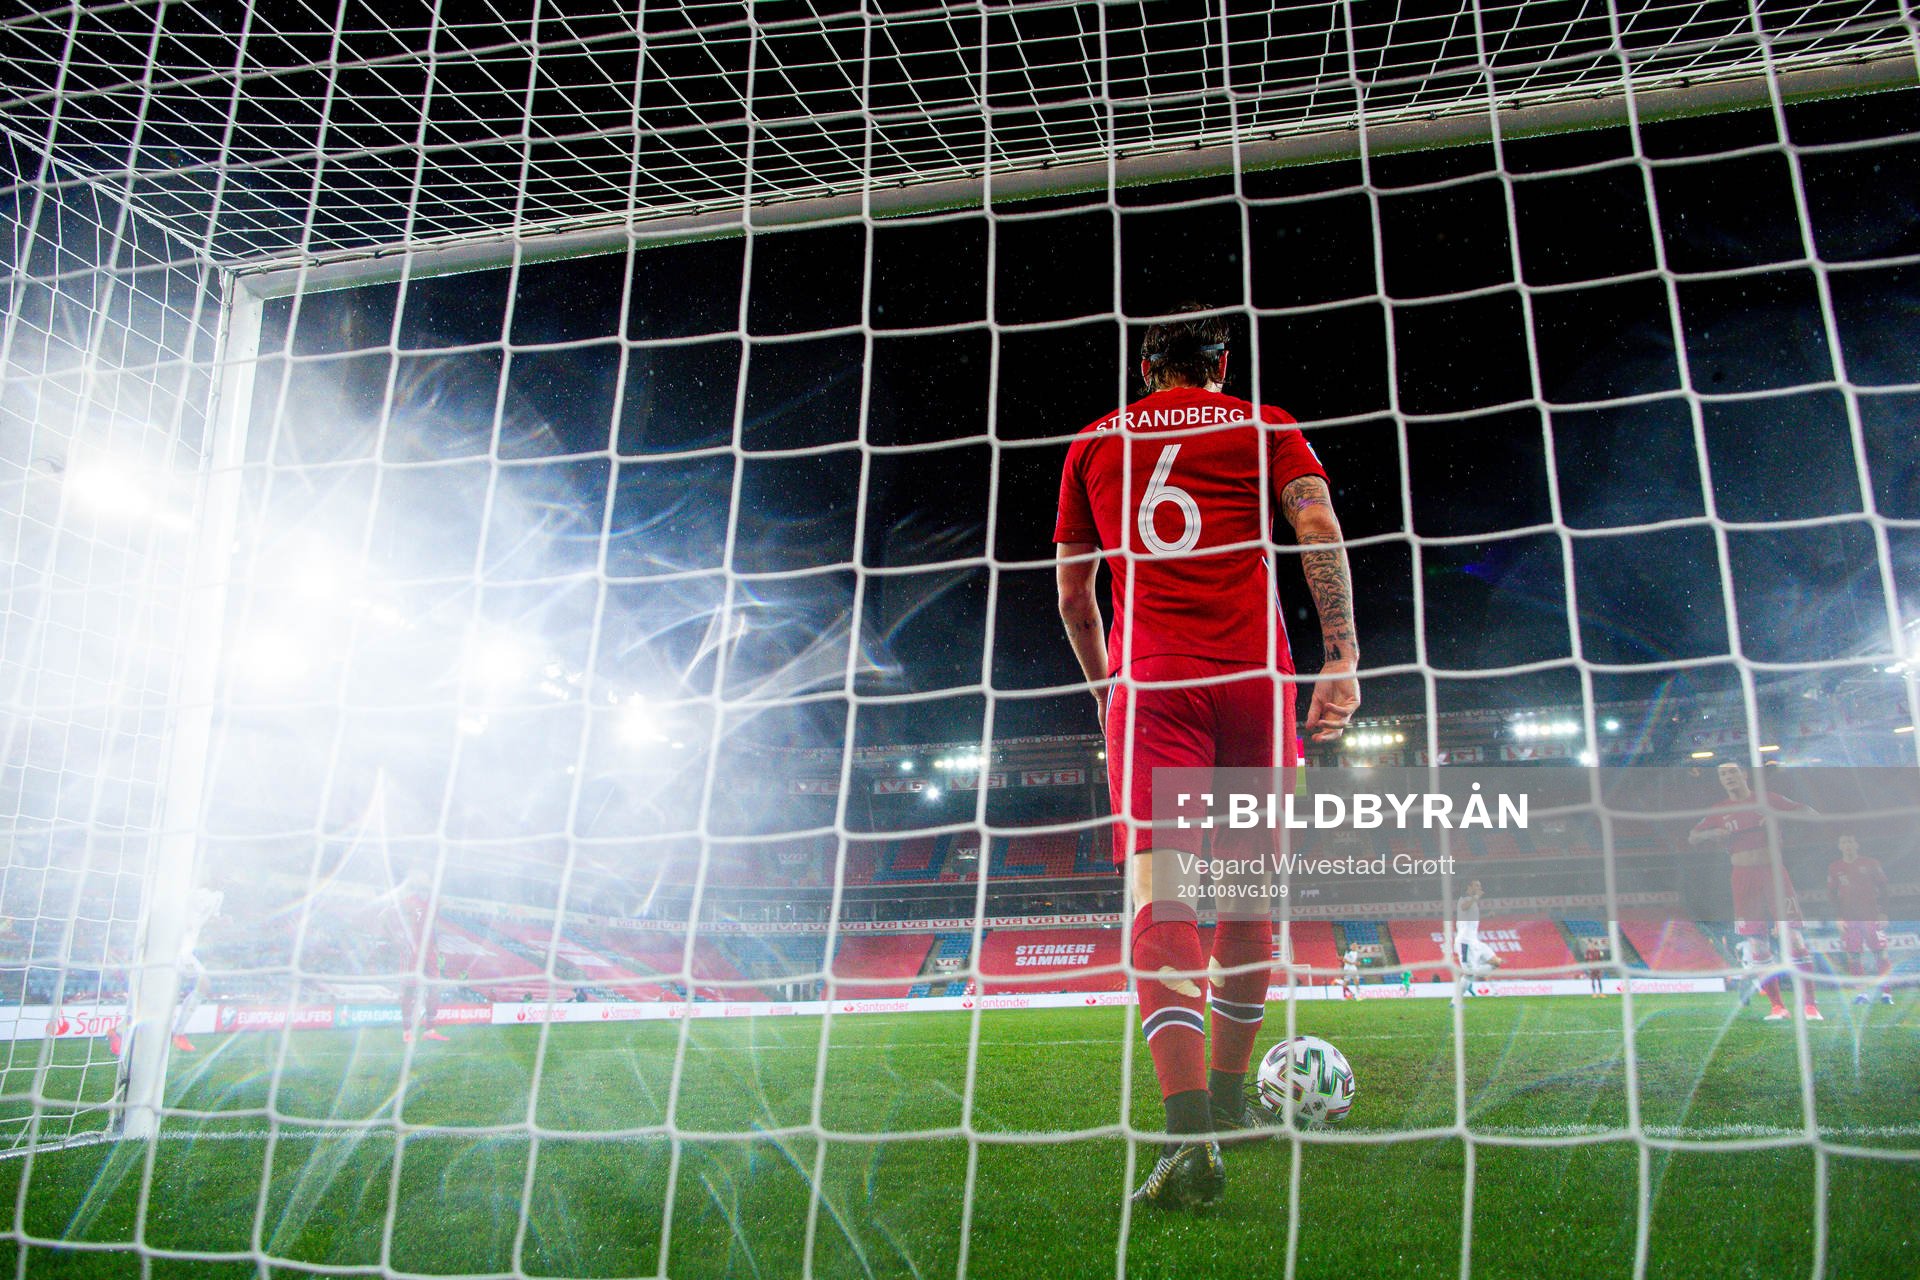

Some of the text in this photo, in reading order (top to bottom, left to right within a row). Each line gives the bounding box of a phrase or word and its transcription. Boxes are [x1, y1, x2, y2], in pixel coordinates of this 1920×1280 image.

[1096, 406, 1245, 435] STRANDBERG
[1138, 443, 1202, 556] 6
[1026, 771, 1079, 785] VG
[1060, 915, 1086, 923] VG
[1092, 914, 1120, 922] VG
[1015, 944, 1096, 956] STERKERE
[1015, 954, 1089, 967] SAMMEN
[856, 1001, 909, 1013] Santander
[978, 997, 1030, 1009] antander
